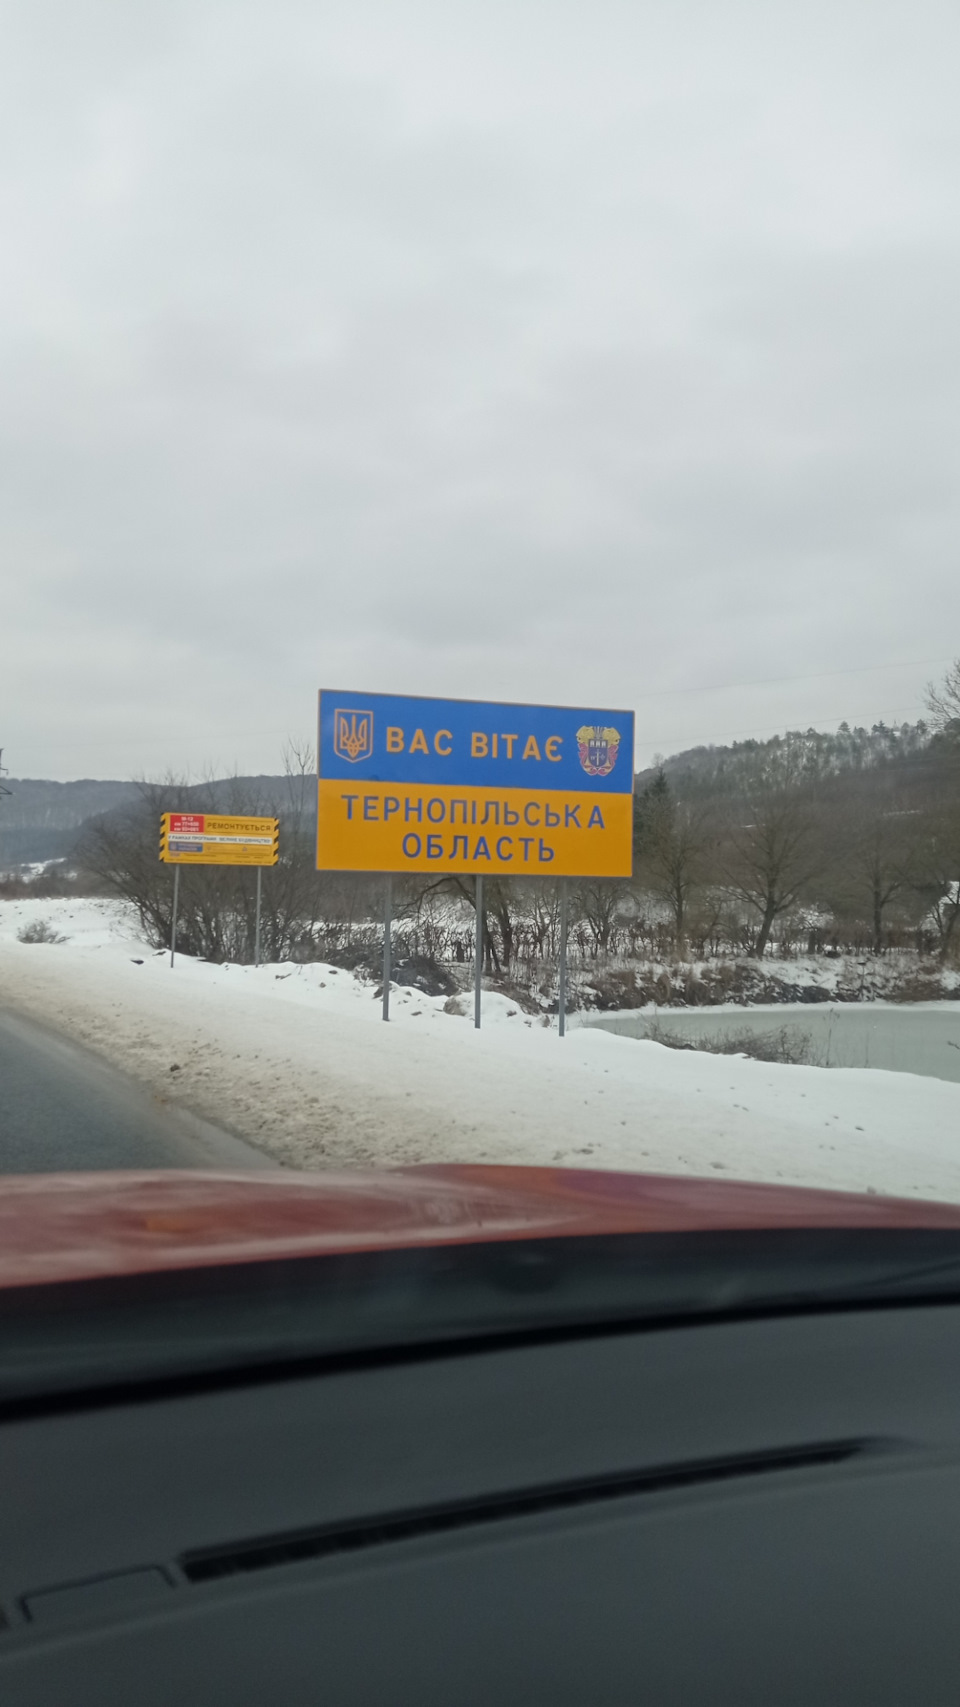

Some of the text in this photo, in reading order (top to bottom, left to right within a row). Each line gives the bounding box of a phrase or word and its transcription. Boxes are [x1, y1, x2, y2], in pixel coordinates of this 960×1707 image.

[386, 726, 564, 762] ВАС ВІТАЄ
[207, 822, 271, 831] РЕМОНТУЄТЬСЯ
[340, 794, 606, 829] ТЕРНОПІЛЬСЬКА
[402, 833, 555, 863] ОБЛАСТЬ
